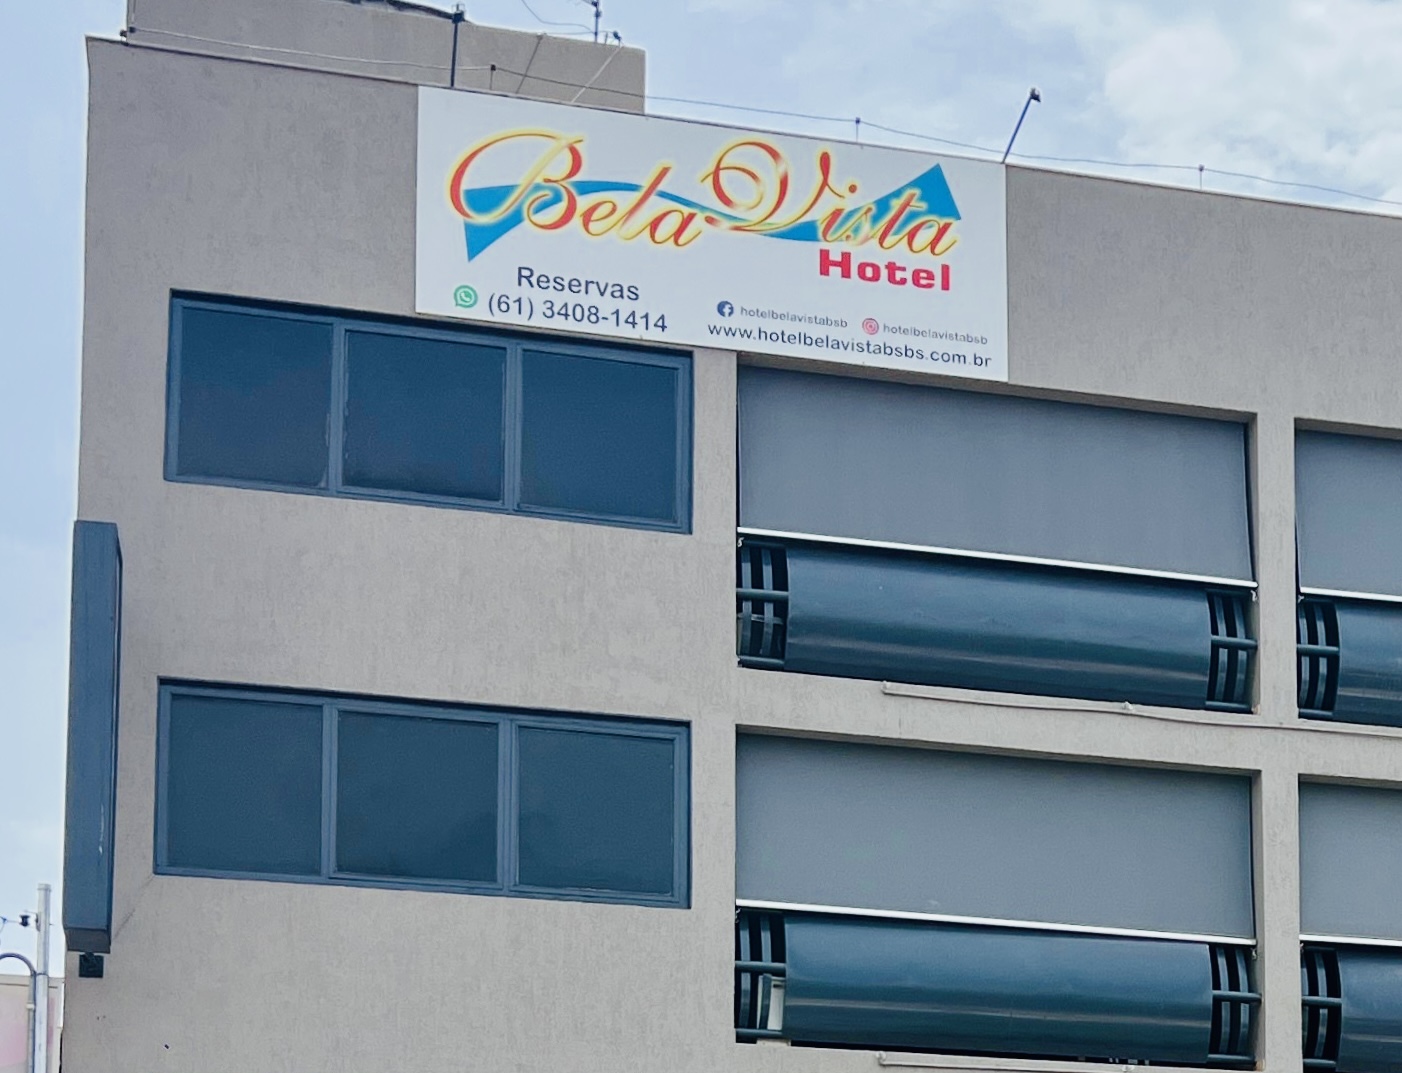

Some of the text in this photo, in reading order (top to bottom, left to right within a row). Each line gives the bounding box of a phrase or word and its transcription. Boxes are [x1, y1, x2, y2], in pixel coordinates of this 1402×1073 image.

[449, 131, 957, 256] Bela Vista
[517, 266, 640, 301] Reservas
[819, 248, 950, 291] Hotel
[488, 293, 668, 332] (61) 3408-1414
[740, 305, 848, 328] hotelbelavistabsb
[707, 323, 992, 367] www.hotelbelavistabsbs.com.br
[882, 323, 988, 345] hotelbelavistabsb
